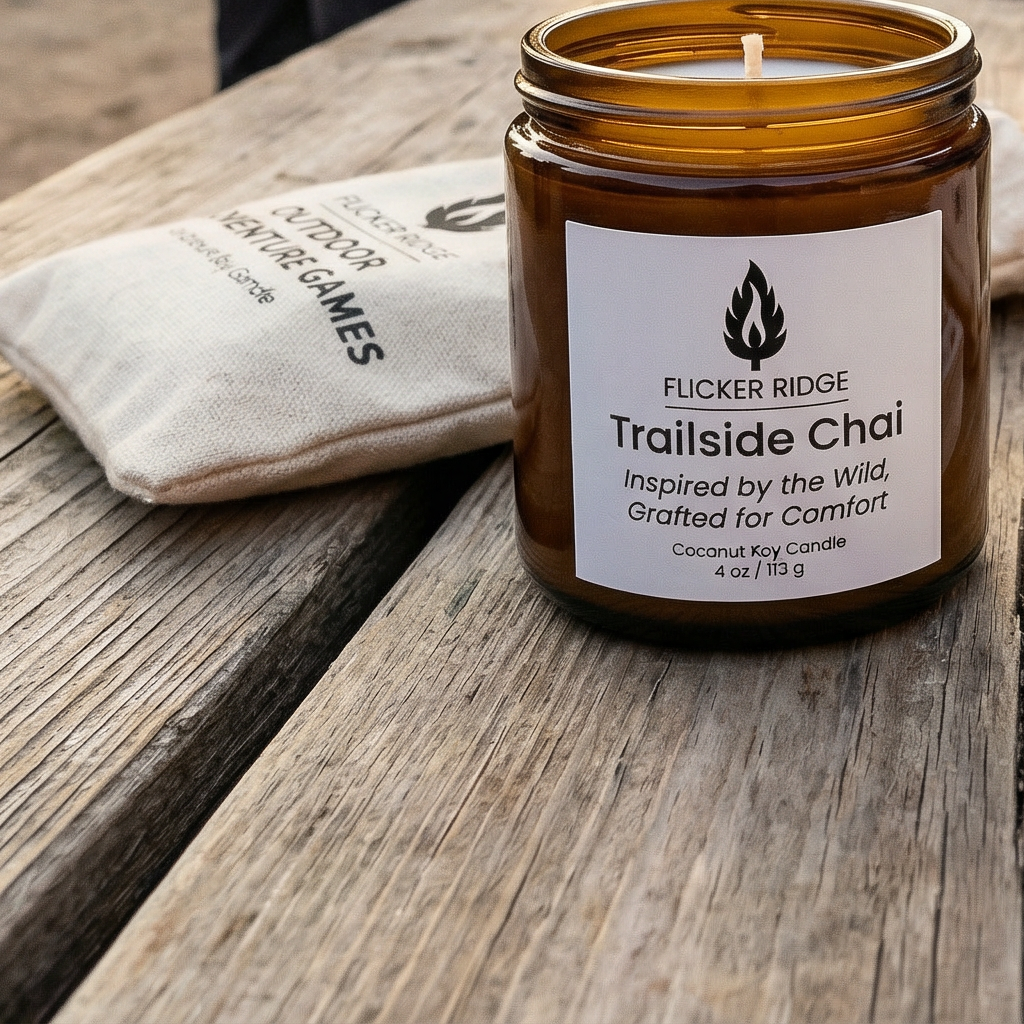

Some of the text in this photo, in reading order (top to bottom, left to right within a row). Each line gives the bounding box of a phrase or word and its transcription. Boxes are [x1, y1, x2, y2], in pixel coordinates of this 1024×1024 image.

[271, 205, 387, 271] OUTDOOR
[209, 210, 318, 270] VENTURE
[298, 268, 385, 366] GAMES
[664, 370, 849, 400] FLICKER RIDGE
[610, 400, 903, 457] Trailside Chai
[624, 458, 890, 503] Inspired by the Wild,
[628, 501, 728, 529] Grafted
[736, 506, 773, 529] for
[751, 545, 781, 561] Koy
[786, 535, 847, 555] Candle
[715, 560, 804, 580] 4 oz / 113 g
